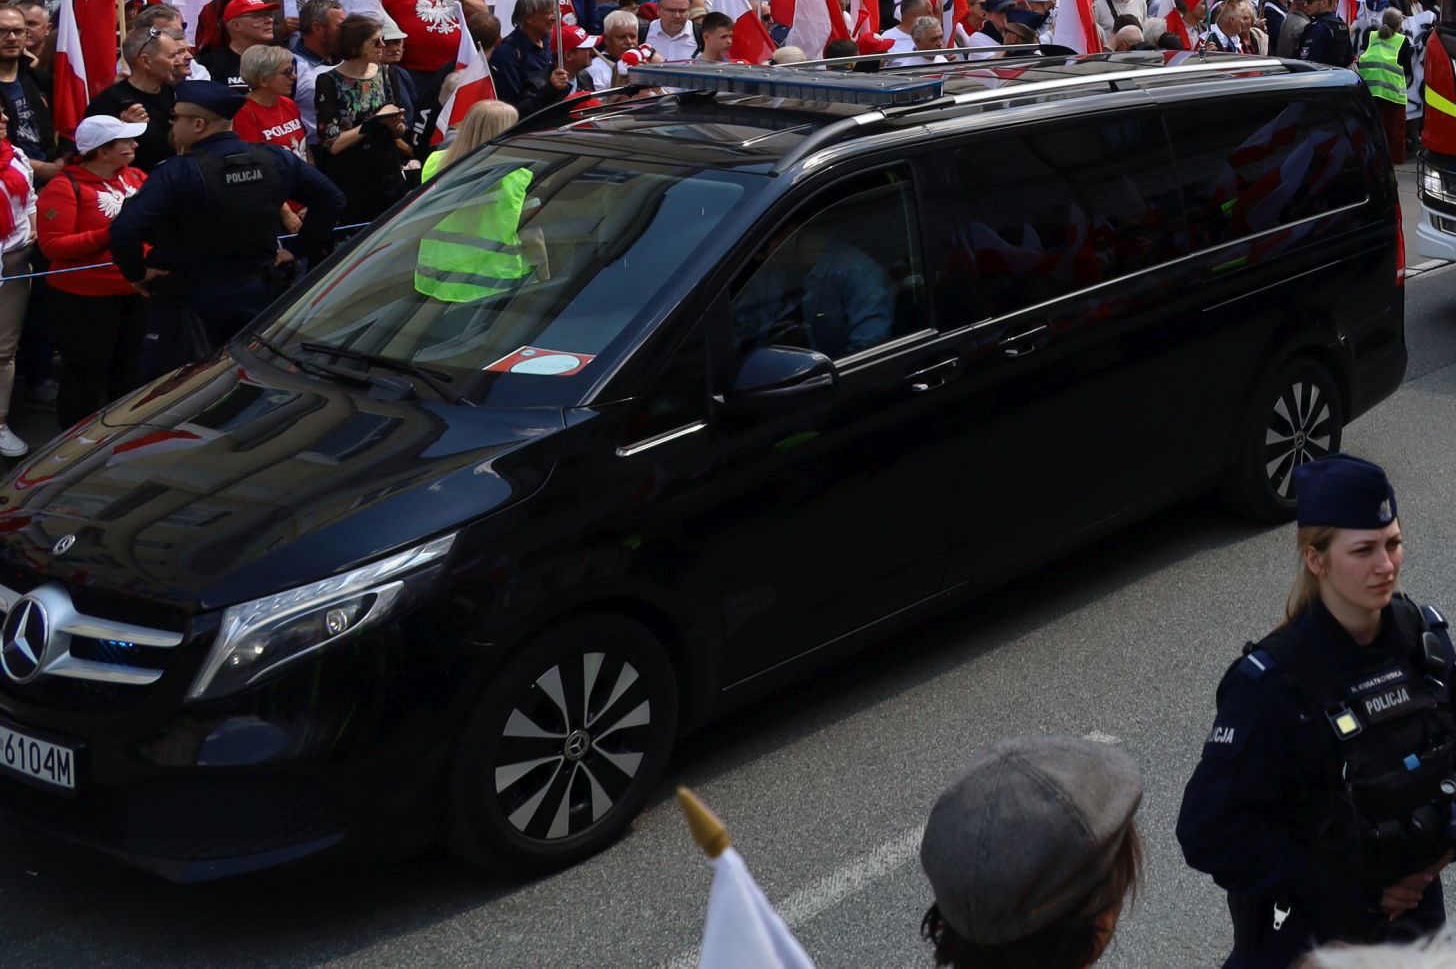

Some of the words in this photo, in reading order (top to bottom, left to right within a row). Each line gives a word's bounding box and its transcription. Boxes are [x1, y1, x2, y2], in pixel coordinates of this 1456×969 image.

[226, 169, 263, 184] POLICJA
[1365, 687, 1410, 715] POLICJA
[5, 733, 71, 785] 6104M
